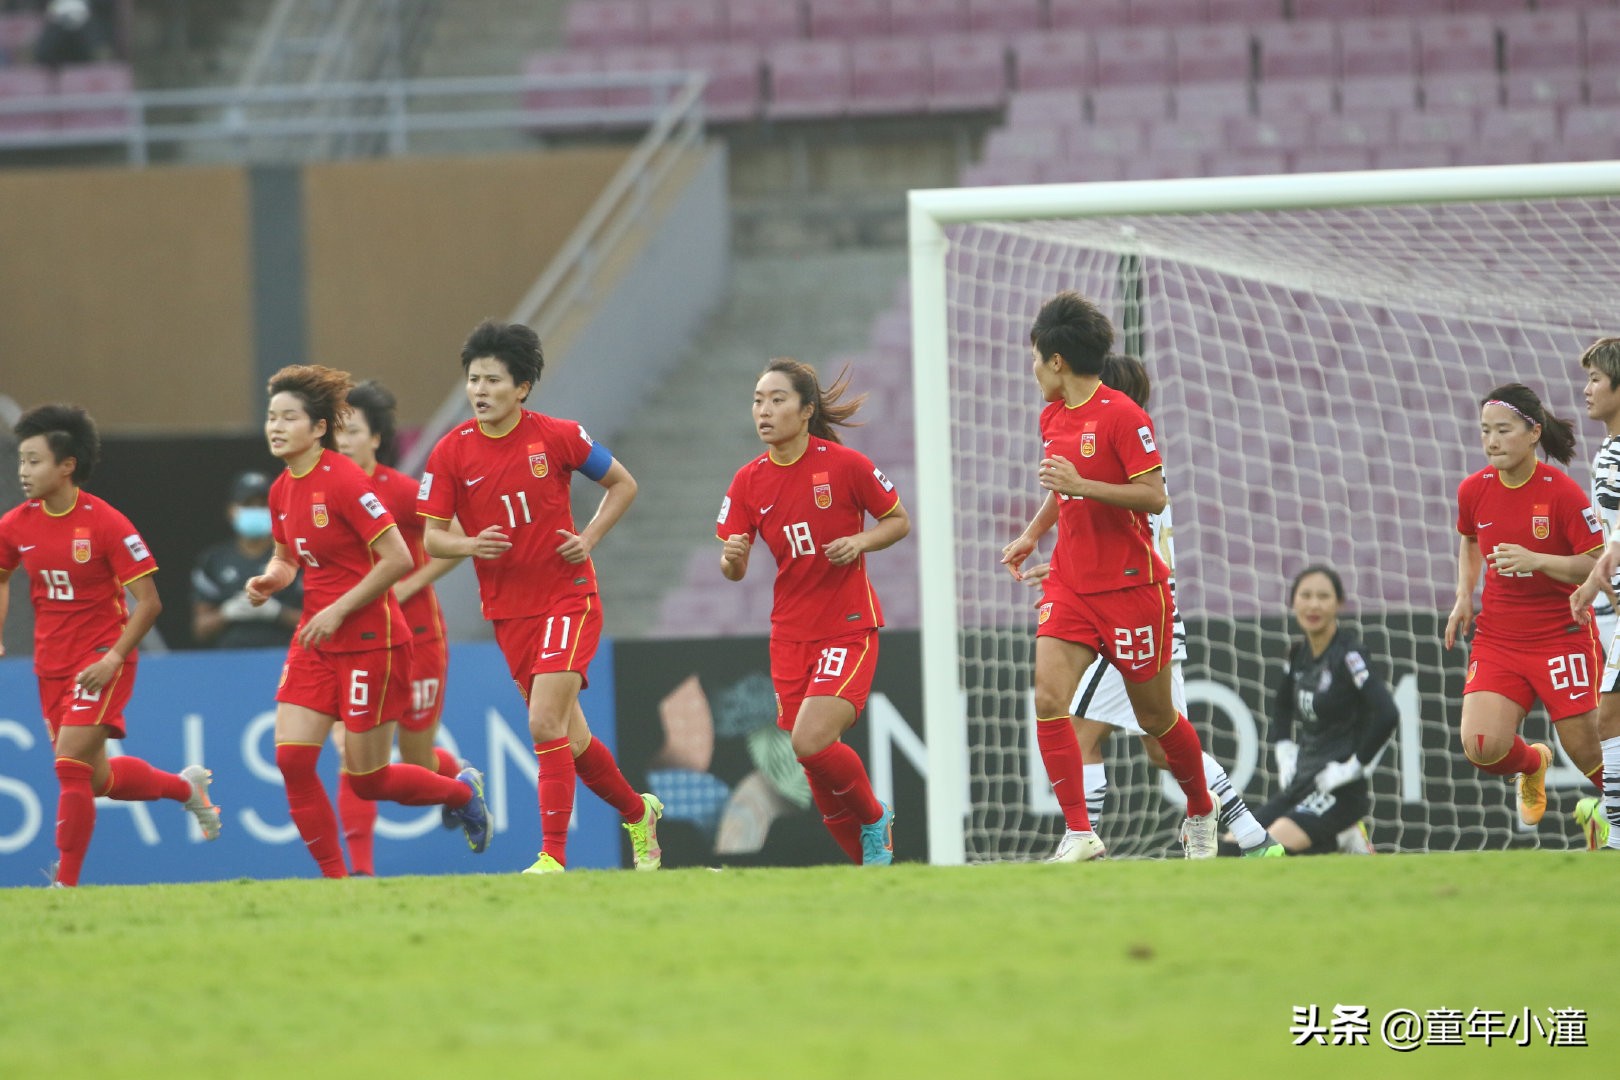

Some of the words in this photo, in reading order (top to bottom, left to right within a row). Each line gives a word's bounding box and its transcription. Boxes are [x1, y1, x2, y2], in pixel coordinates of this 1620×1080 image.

[501, 491, 531, 528] 11
[783, 521, 815, 558] 18
[40, 570, 74, 600] 19
[543, 616, 570, 649] 11
[1115, 625, 1154, 660] 23
[816, 647, 847, 676] 18
[1548, 653, 1589, 690] 20
[350, 669, 368, 705] 6
[412, 678, 439, 710] 10
